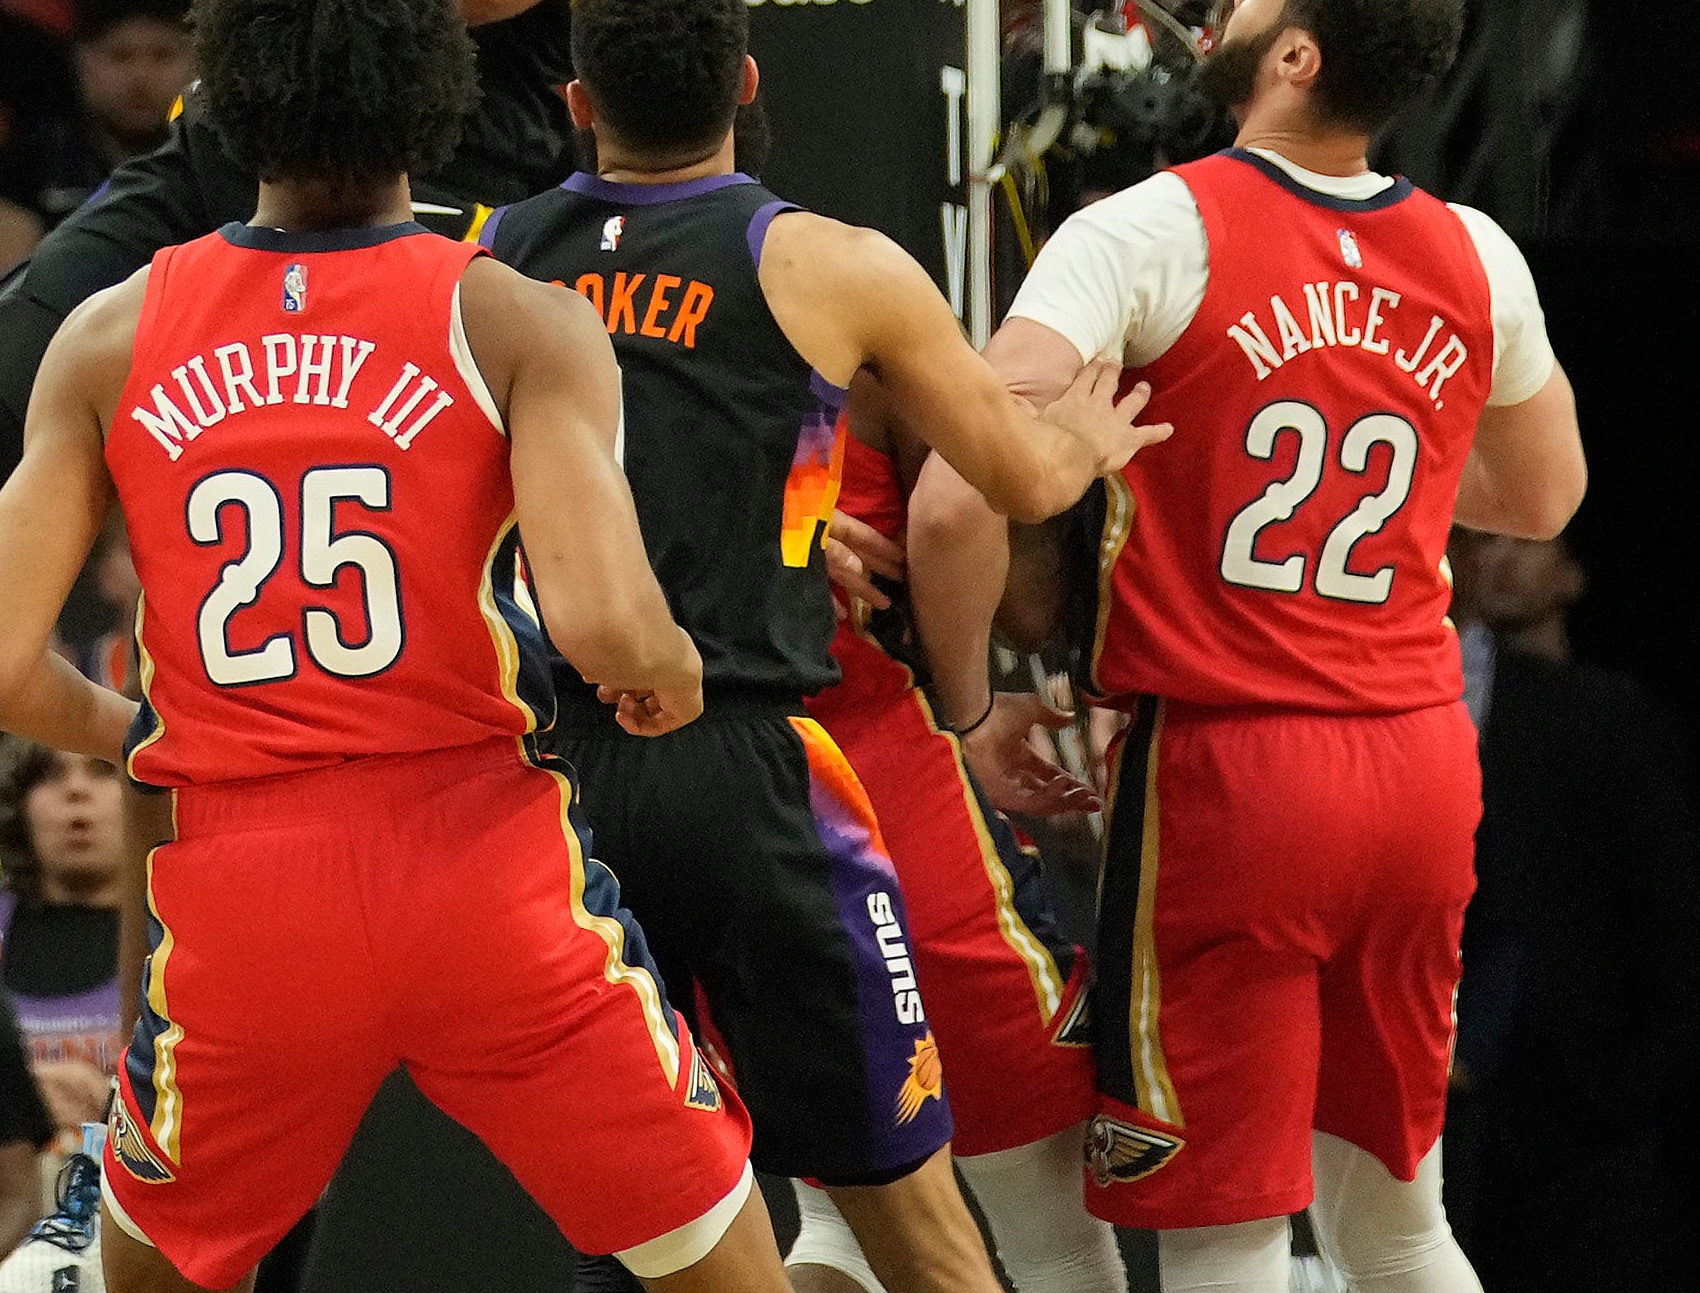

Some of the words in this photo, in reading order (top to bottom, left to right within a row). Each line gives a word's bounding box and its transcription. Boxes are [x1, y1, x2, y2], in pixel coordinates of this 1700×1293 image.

[131, 333, 376, 461] MURPHY
[368, 361, 454, 451] III
[1227, 281, 1401, 380] NANCE
[1395, 315, 1467, 410] JR.
[186, 464, 406, 686] 25
[1219, 400, 1419, 604] 22
